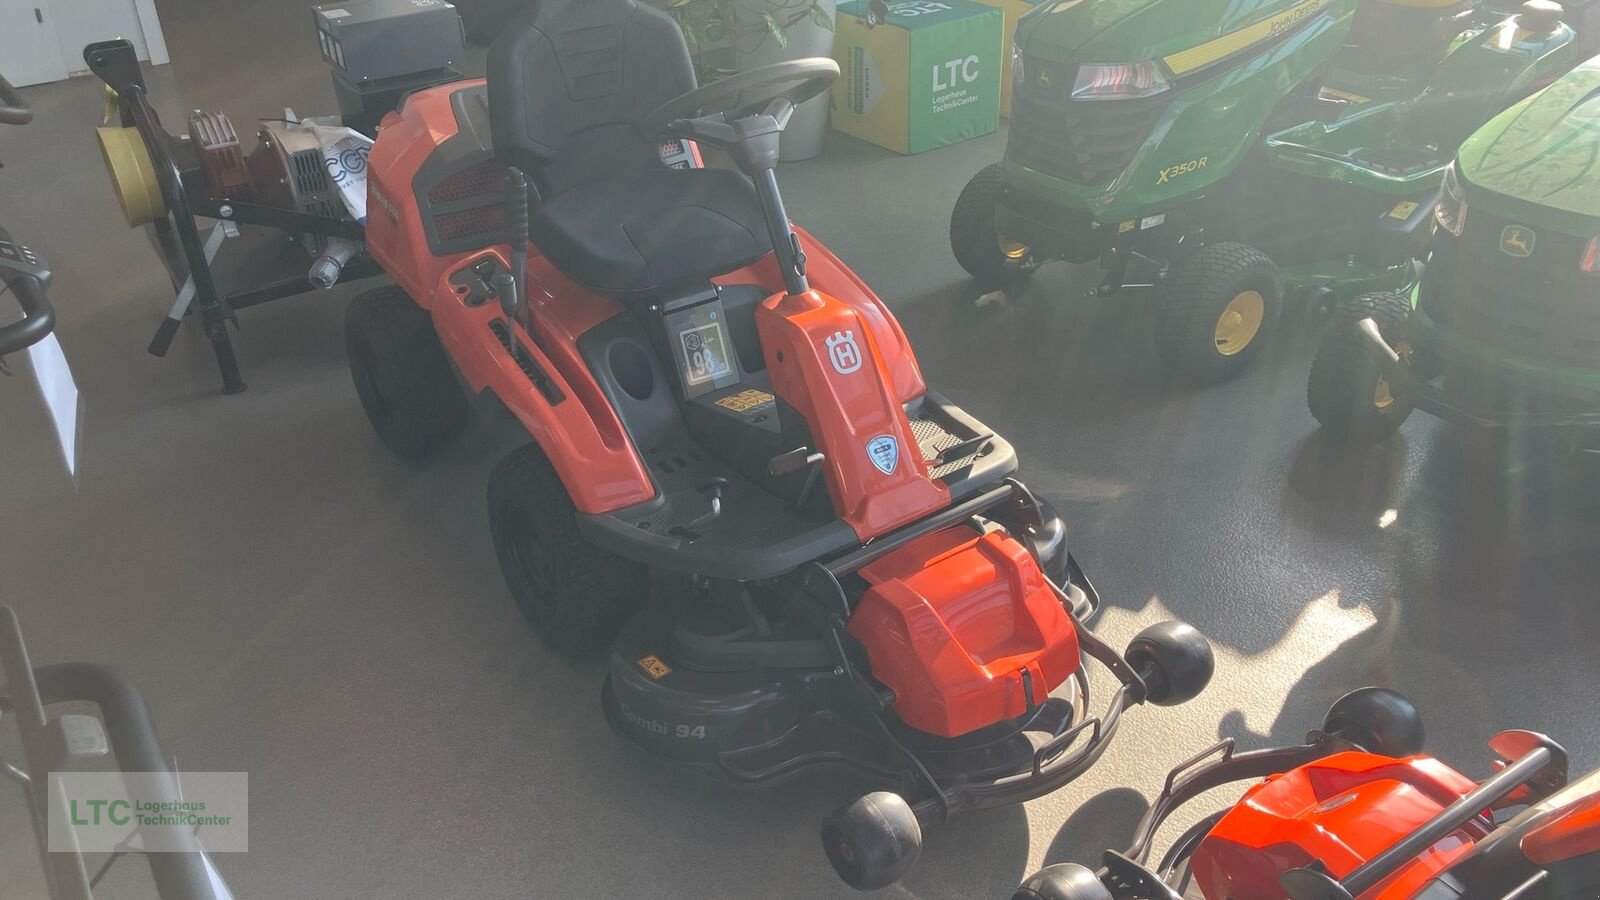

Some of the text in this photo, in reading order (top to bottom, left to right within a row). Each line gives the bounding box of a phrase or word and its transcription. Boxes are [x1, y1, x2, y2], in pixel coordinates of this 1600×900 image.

[1267, 14, 1294, 36] JOHN
[932, 54, 980, 92] LTC
[932, 89, 967, 105] Lagerhaus
[932, 95, 979, 113] TechnikCenter
[692, 348, 715, 376] 98
[675, 724, 706, 740] 94
